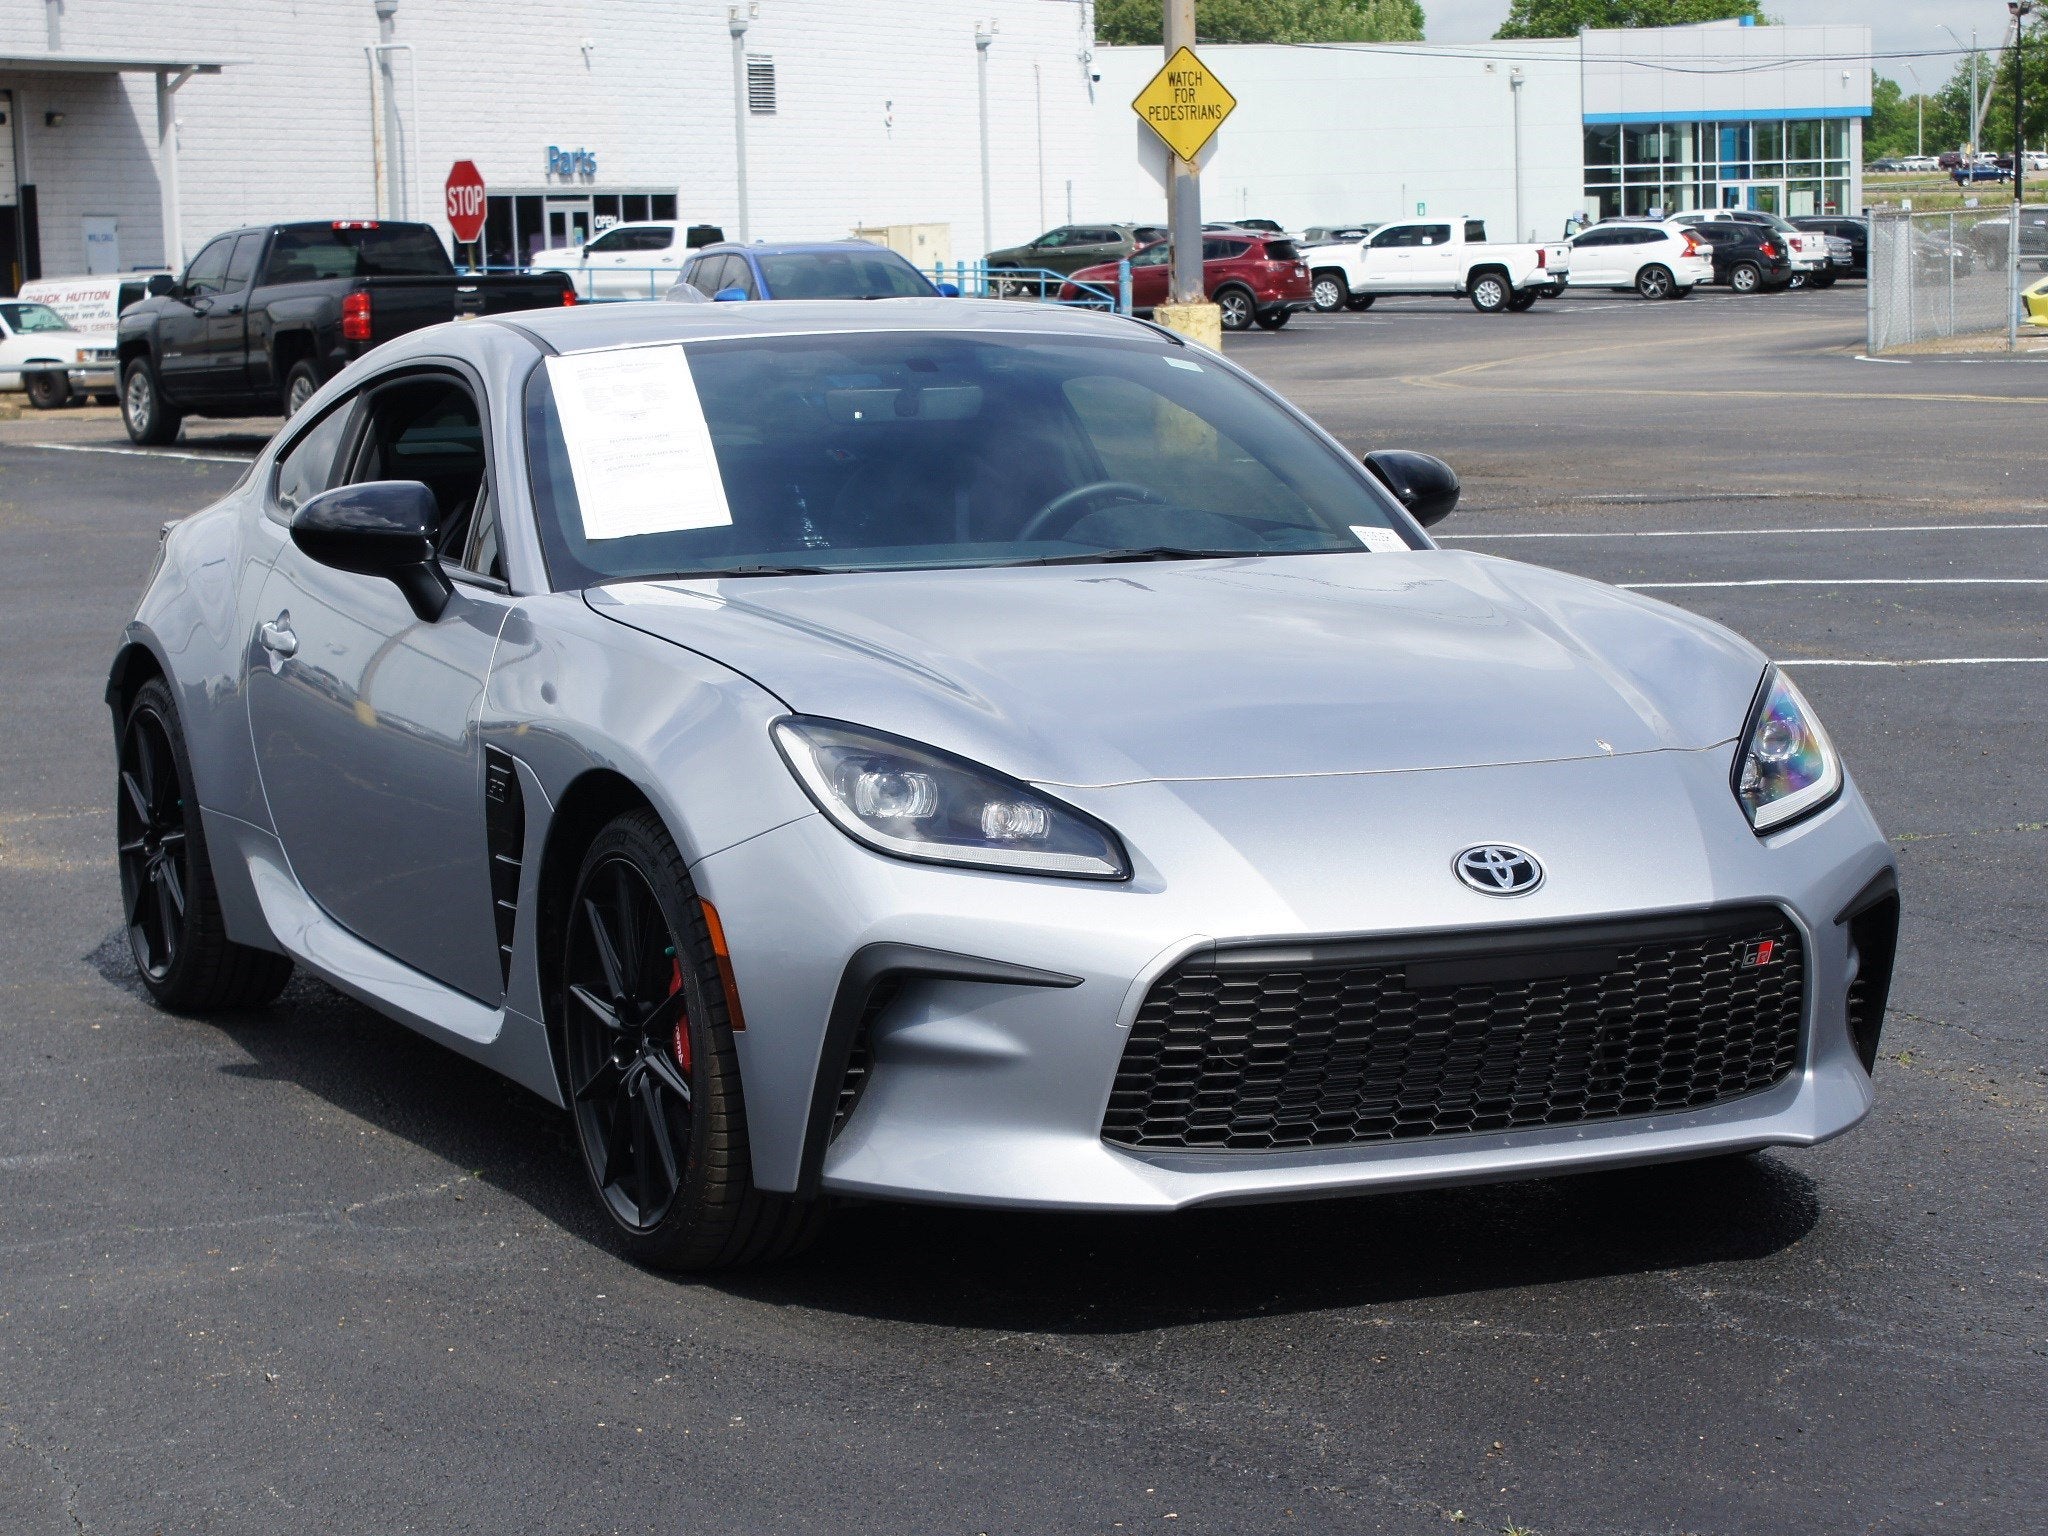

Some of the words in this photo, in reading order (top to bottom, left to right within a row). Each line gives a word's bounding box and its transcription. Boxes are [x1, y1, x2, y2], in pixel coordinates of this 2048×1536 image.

[1167, 71, 1202, 87] WATCH
[1174, 88, 1196, 103] FOR
[1148, 104, 1222, 121] PEDESTRIANS
[547, 145, 597, 175] Parts
[447, 185, 484, 217] STOP
[66, 291, 111, 302] HUTTON
